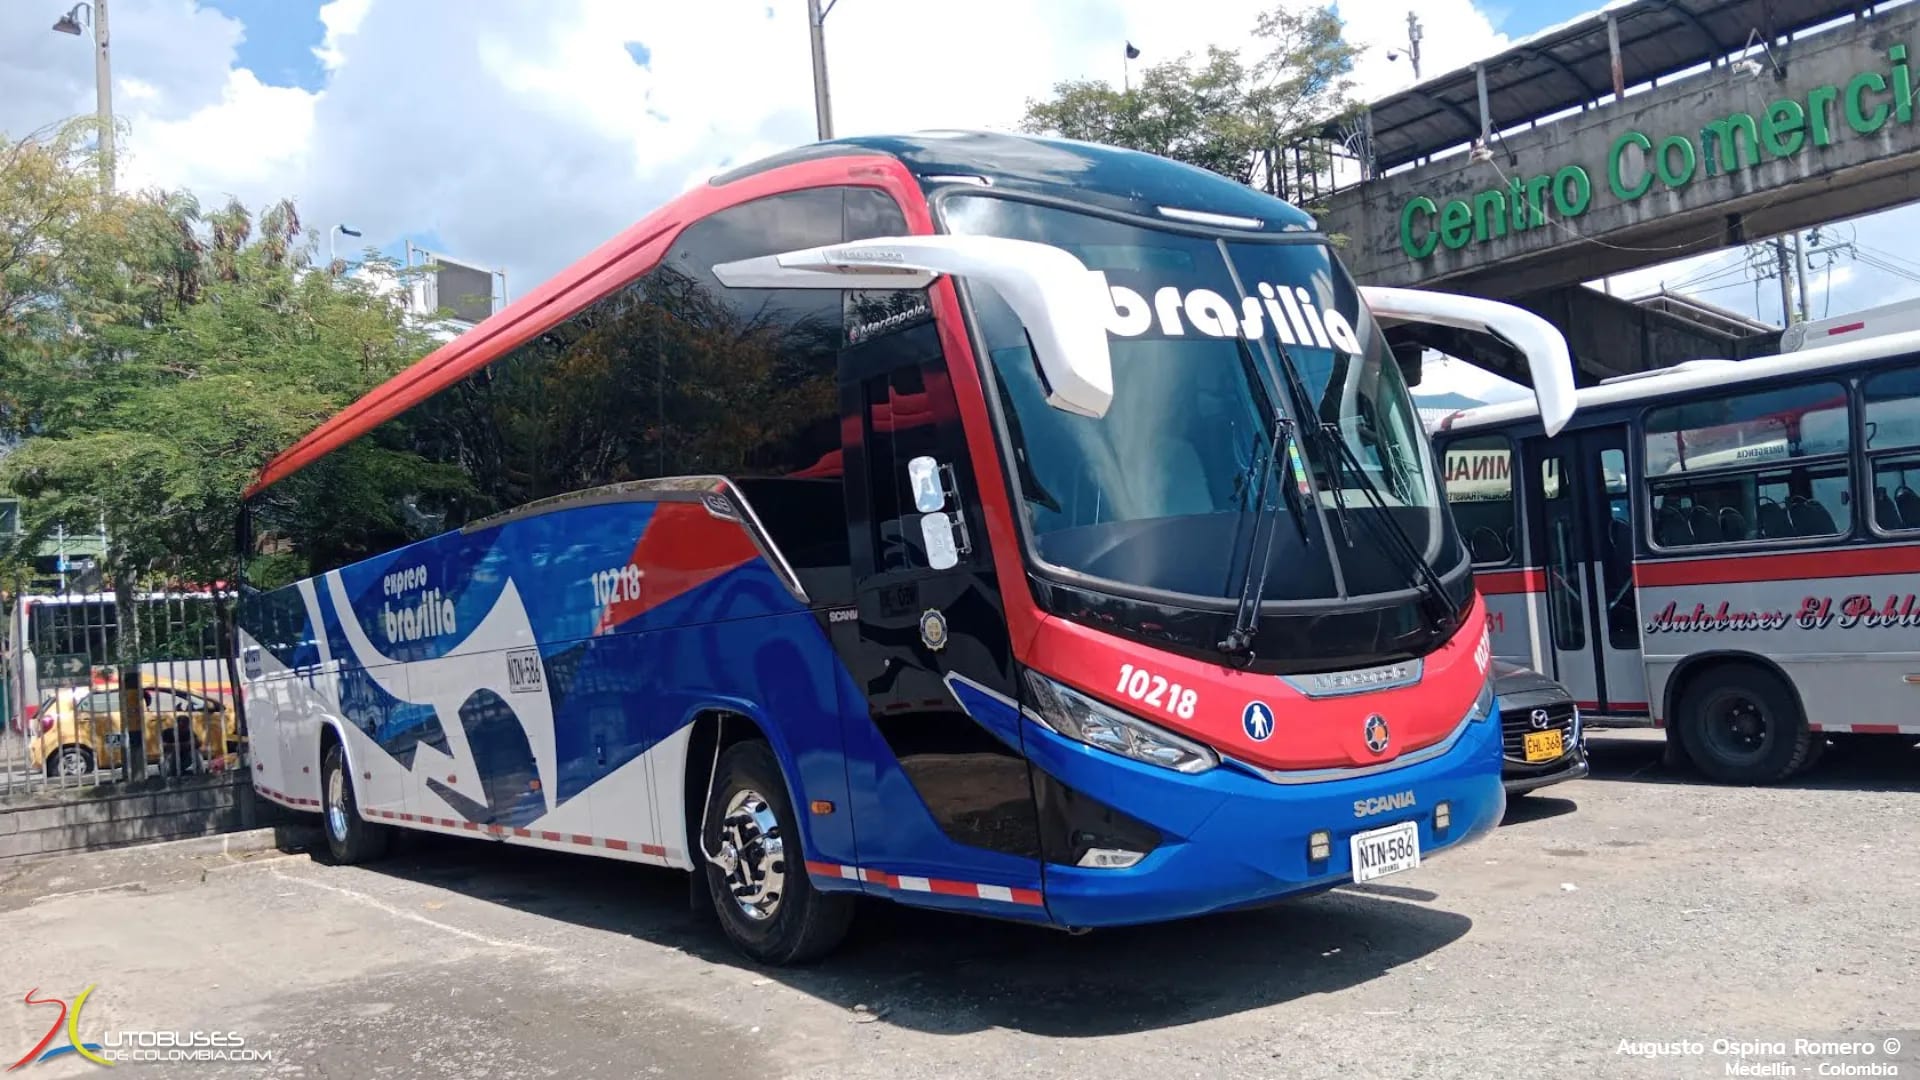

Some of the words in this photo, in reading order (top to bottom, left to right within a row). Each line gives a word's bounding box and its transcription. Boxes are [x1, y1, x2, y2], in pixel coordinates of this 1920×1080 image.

[1399, 164, 1591, 260] Centro
[1608, 44, 1920, 201] Comerci
[860, 304, 926, 335] Marcopolo
[1087, 270, 1363, 355] brasilia
[384, 564, 427, 599] expreso
[591, 563, 642, 607] 10218
[384, 587, 457, 644] brasilia
[1646, 599, 1791, 634] Autobuses
[1794, 594, 1836, 630] El
[508, 655, 542, 686] NIN-586
[1116, 663, 1198, 720] 10218
[1353, 789, 1416, 818] SCANIA
[1360, 834, 1413, 869] NIN-586
